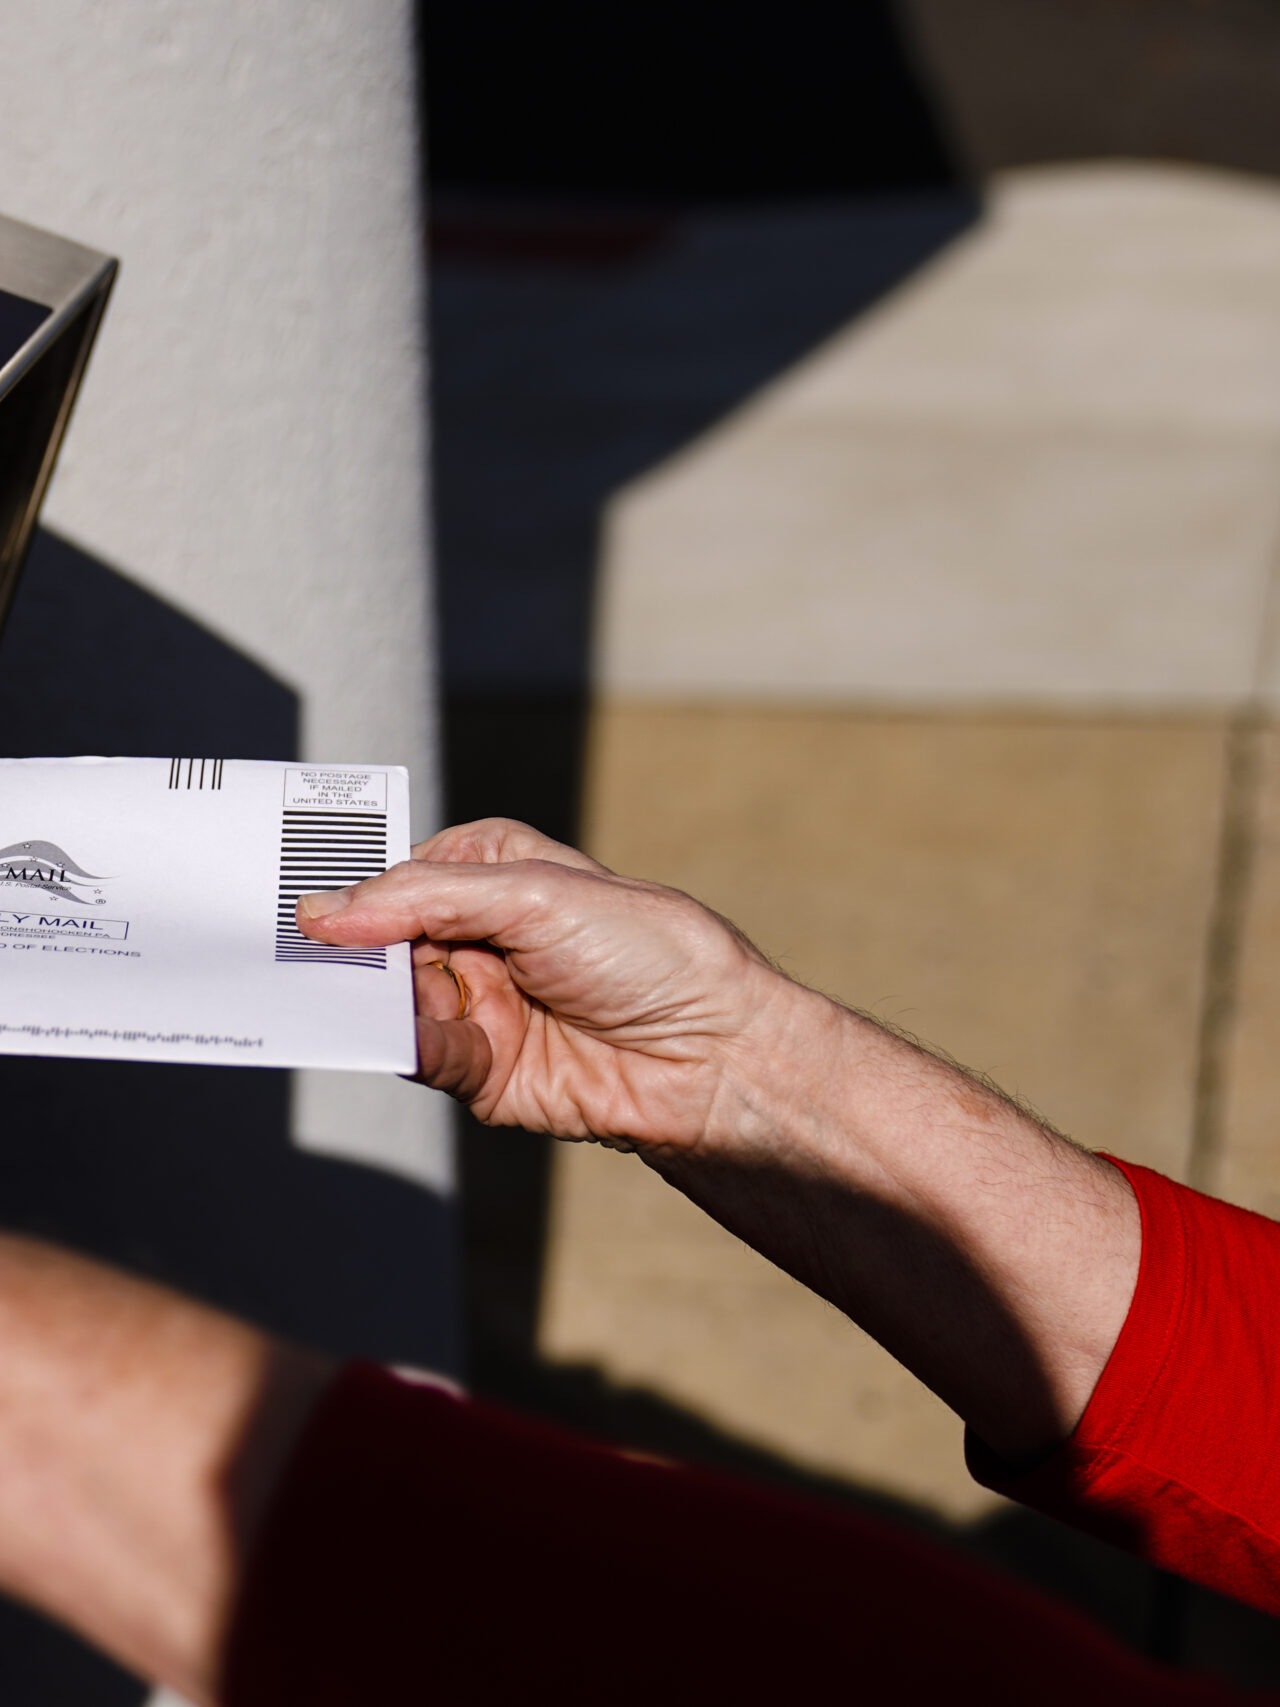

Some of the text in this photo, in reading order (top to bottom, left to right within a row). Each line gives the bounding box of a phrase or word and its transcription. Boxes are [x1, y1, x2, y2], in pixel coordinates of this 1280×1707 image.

[319, 771, 372, 780] POSTAGE
[302, 777, 369, 786] NECESSARY
[321, 785, 363, 793] MAILED
[331, 791, 353, 799] THE
[292, 797, 333, 805] UNITED
[5, 867, 72, 883] MAIL
[38, 916, 104, 931] MAIL
[12, 943, 36, 951] OF
[42, 945, 141, 958] ELECTIONS
